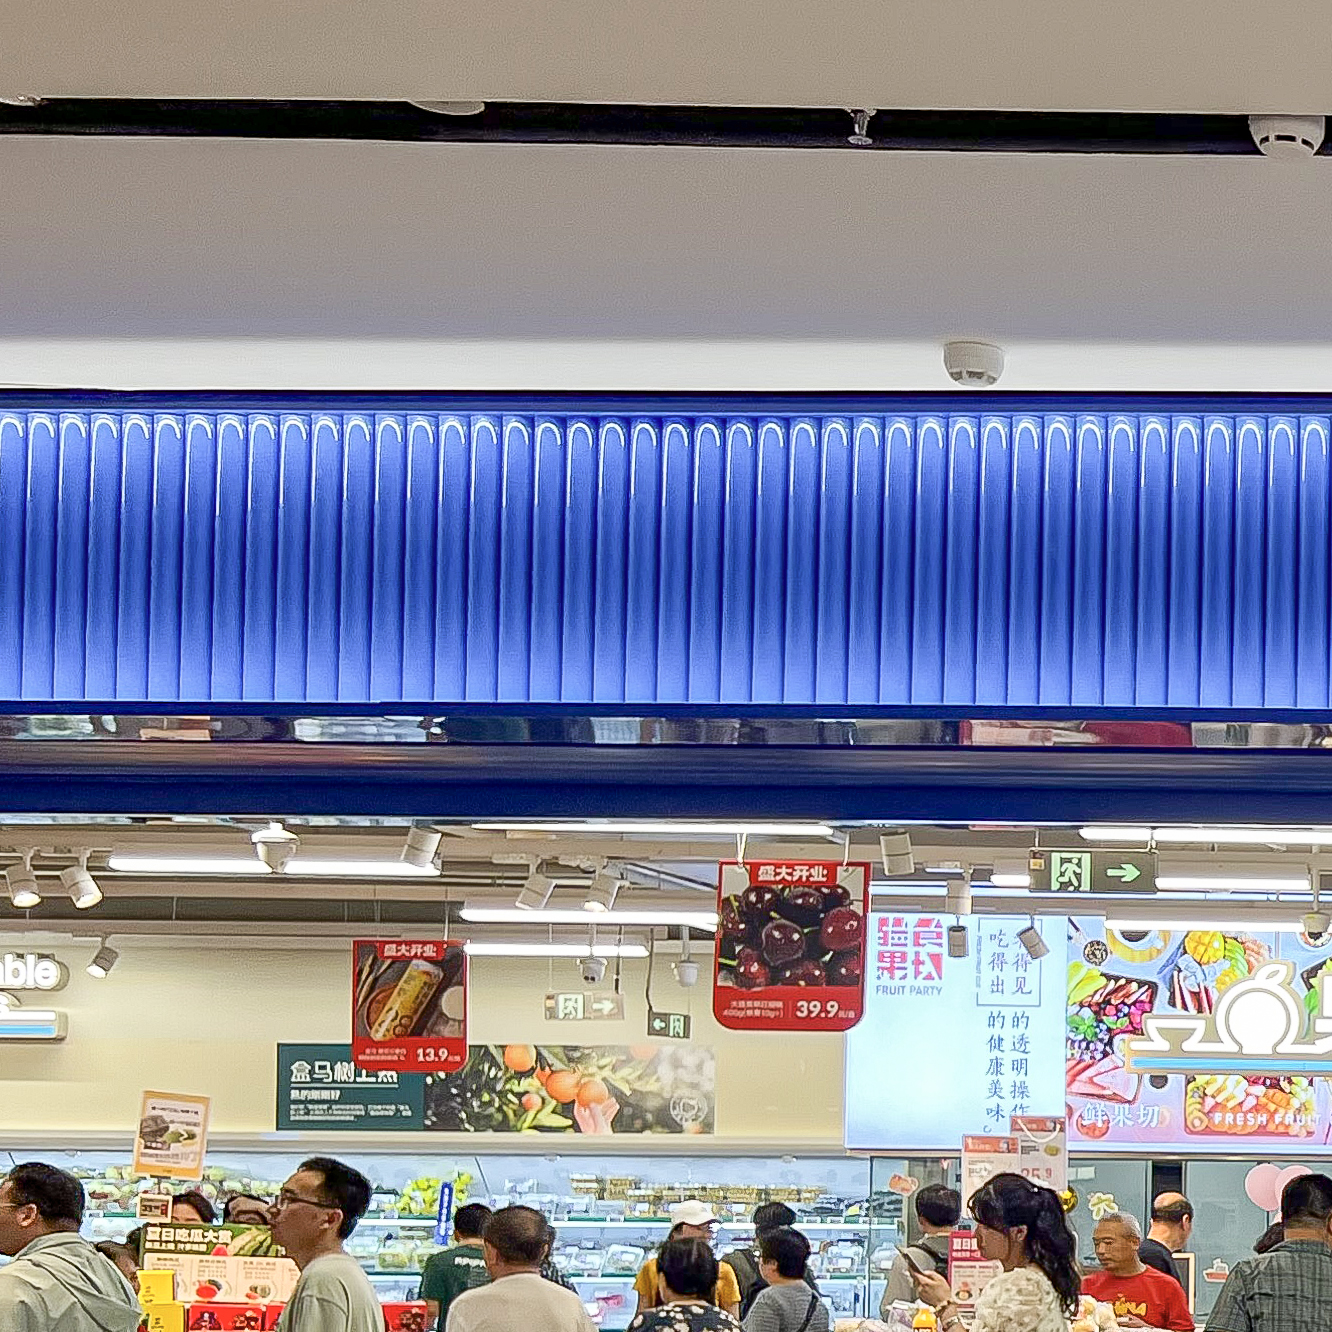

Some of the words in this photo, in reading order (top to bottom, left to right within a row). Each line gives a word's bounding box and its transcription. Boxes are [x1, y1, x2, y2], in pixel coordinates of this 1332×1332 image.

[758, 865, 828, 882] 盛大开业
[0, 954, 57, 987] ble
[876, 985, 906, 996] FRUIT
[909, 985, 943, 996] PARTY
[796, 1000, 839, 1018] 39.9
[417, 1047, 449, 1062] 13.9
[1082, 1103, 1160, 1128] 鲜果切
[1214, 1112, 1267, 1126] FRESH
[1274, 1112, 1322, 1127] FRUIT
